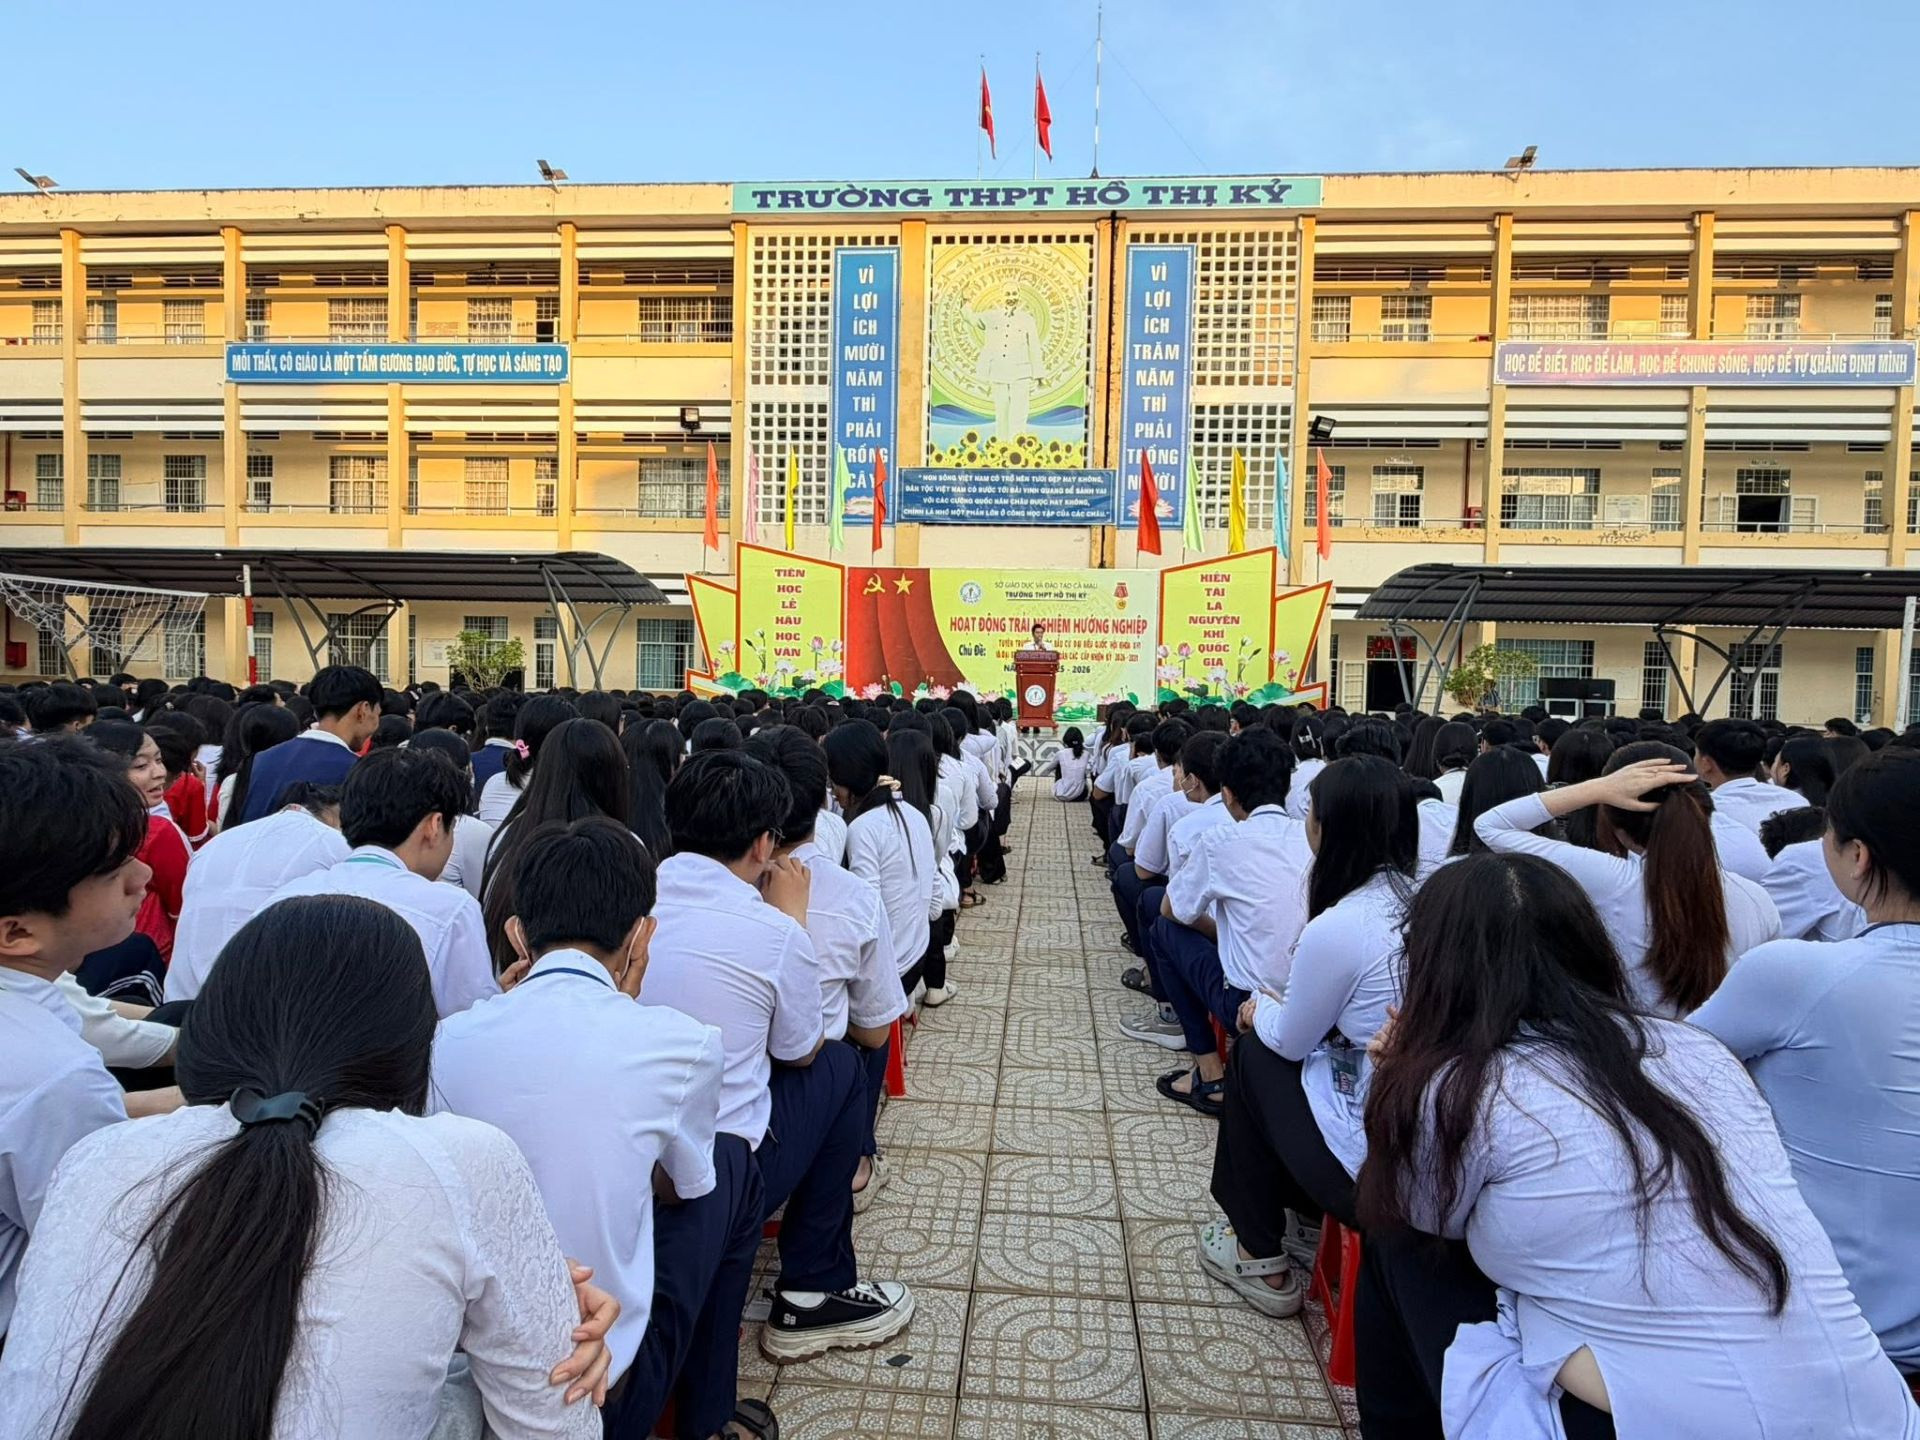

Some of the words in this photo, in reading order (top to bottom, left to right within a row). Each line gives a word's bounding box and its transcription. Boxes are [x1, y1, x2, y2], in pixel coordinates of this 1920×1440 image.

[752, 184, 932, 208] TRƯỜNG
[944, 187, 1053, 207] THPT
[1066, 180, 1130, 205] HỒ
[1142, 185, 1218, 207] THỊ
[1229, 179, 1292, 204] KỶ
[859, 264, 874, 284] VÌ
[1151, 262, 1167, 281] VÌ
[853, 291, 878, 312] LỢI
[1145, 289, 1171, 310] LỢI
[853, 316, 877, 335] ÍCH
[1144, 314, 1170, 334] ÍCH
[844, 342, 885, 361] MƯỜI
[1132, 341, 1180, 360] TRĂM
[280, 351, 292, 372] CÔ
[295, 351, 318, 372] GIÁO
[320, 351, 334, 372] LÀ
[334, 351, 354, 376] MỘT
[356, 349, 378, 372] TẤM
[380, 353, 412, 372] GƯƠNG
[415, 354, 435, 376] ĐẠO
[437, 351, 460, 374] ĐỨC,
[462, 353, 476, 376] TỰ
[477, 354, 497, 376] HỌC
[499, 351, 512, 372] VÀ
[514, 351, 541, 372] SÁNG
[543, 354, 562, 376] TẠO
[1505, 353, 1525, 376] HỌC
[1571, 354, 1592, 377] HỌC
[1611, 351, 1636, 376] LÀM,
[1639, 354, 1660, 378] HỌC
[1680, 354, 1715, 374] CHUNG
[1718, 348, 1750, 375] SỐNG,
[1753, 354, 1774, 378] HỌC
[1794, 352, 1810, 377] TỰ
[1809, 346, 1847, 375] KHẲNG
[1849, 354, 1876, 378] ĐỊNH
[1878, 350, 1908, 373] MÌNH
[846, 368, 882, 386] NĂM
[1136, 367, 1175, 386] NĂM
[852, 393, 876, 412] THÌ
[1142, 393, 1167, 412] THÌ
[845, 418, 881, 438] PHẢI
[1134, 418, 1172, 438] PHẢI
[950, 616, 976, 636] HOẠT
[978, 612, 1006, 636] ĐỘNG
[1008, 611, 1029, 633] TRẢI
[1073, 613, 1109, 634] HƯỚNG
[1112, 614, 1148, 639] NGHIỆP
[958, 642, 972, 656] Chủ
[1072, 665, 1091, 674] 2026
[1203, 657, 1224, 667] GIA
